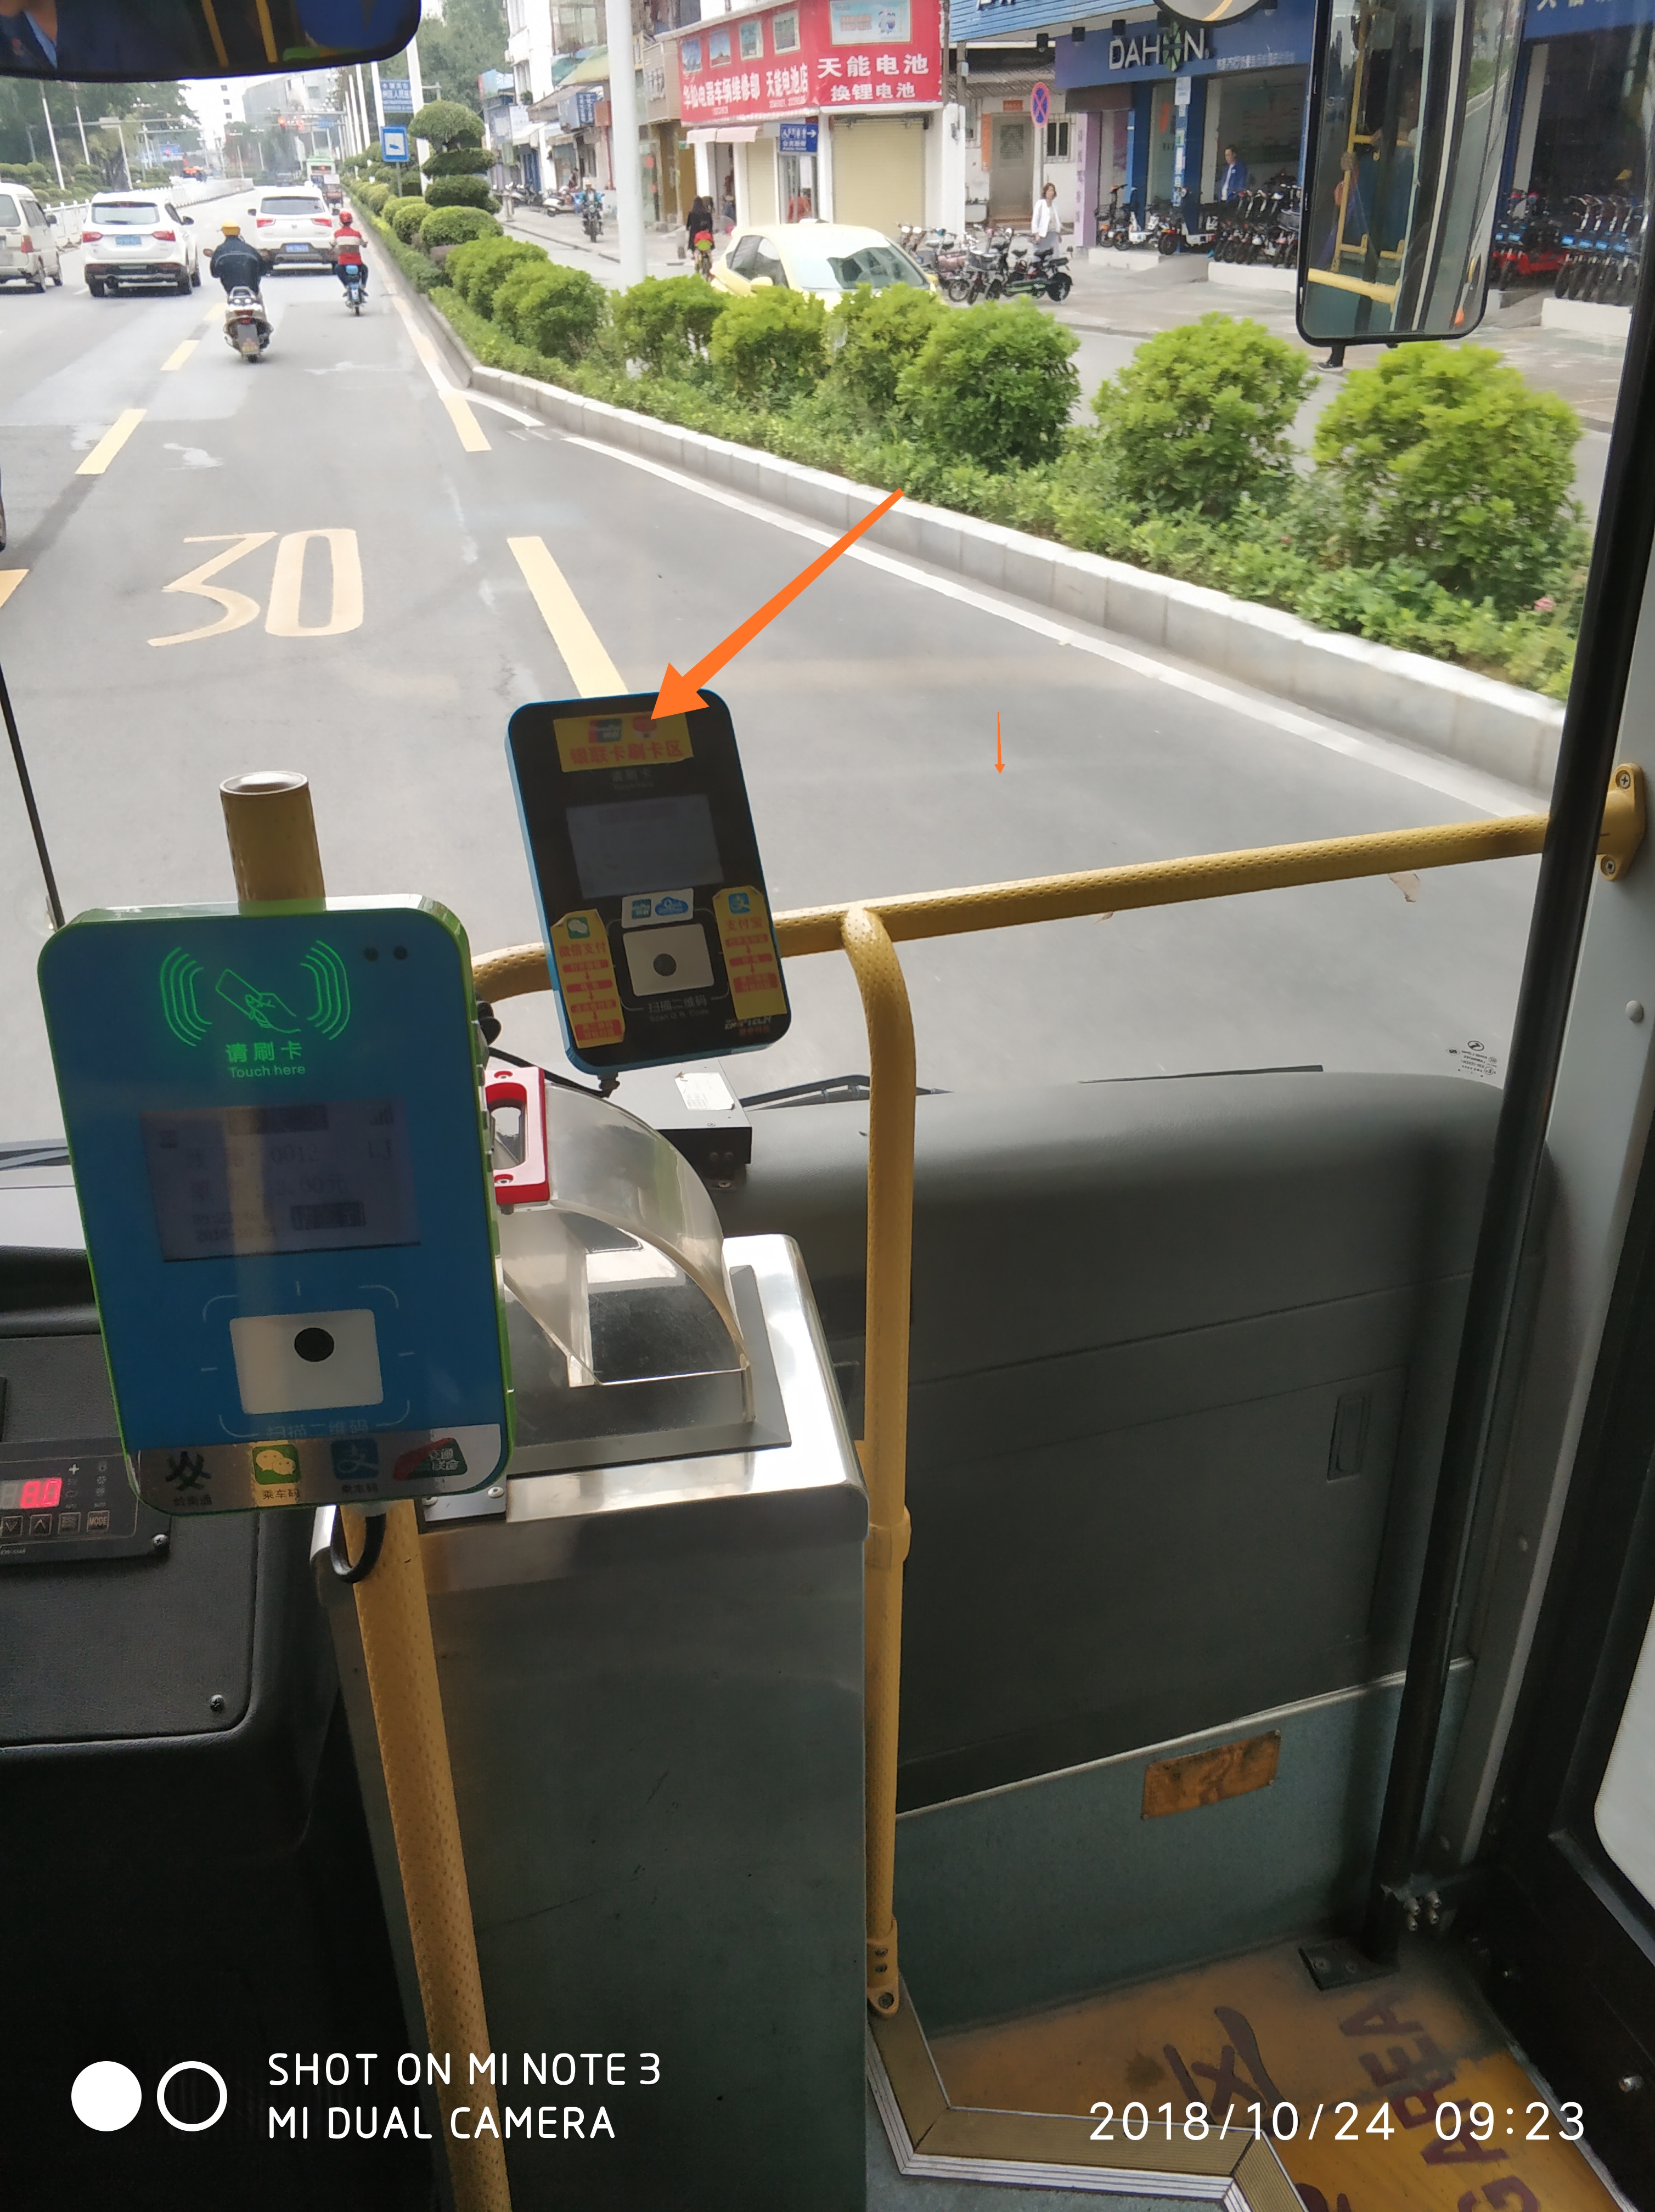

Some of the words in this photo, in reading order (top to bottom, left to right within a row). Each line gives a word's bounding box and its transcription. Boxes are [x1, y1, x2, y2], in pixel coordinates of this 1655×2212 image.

[818, 53, 929, 78] 天能电池
[766, 63, 808, 97] 天能电池店
[830, 82, 915, 101] 换锂电池
[146, 528, 364, 647] 30
[570, 740, 684, 765] 银联卡刷卡区
[725, 916, 763, 932] 支付宝
[559, 941, 606, 957] 微信支付
[226, 1041, 302, 1063] 请刷卡
[228, 1065, 271, 1078] Touch
[274, 1064, 306, 1076] here
[262, 1488, 300, 1500] 乘车码
[89, 1516, 108, 1526] MODE
